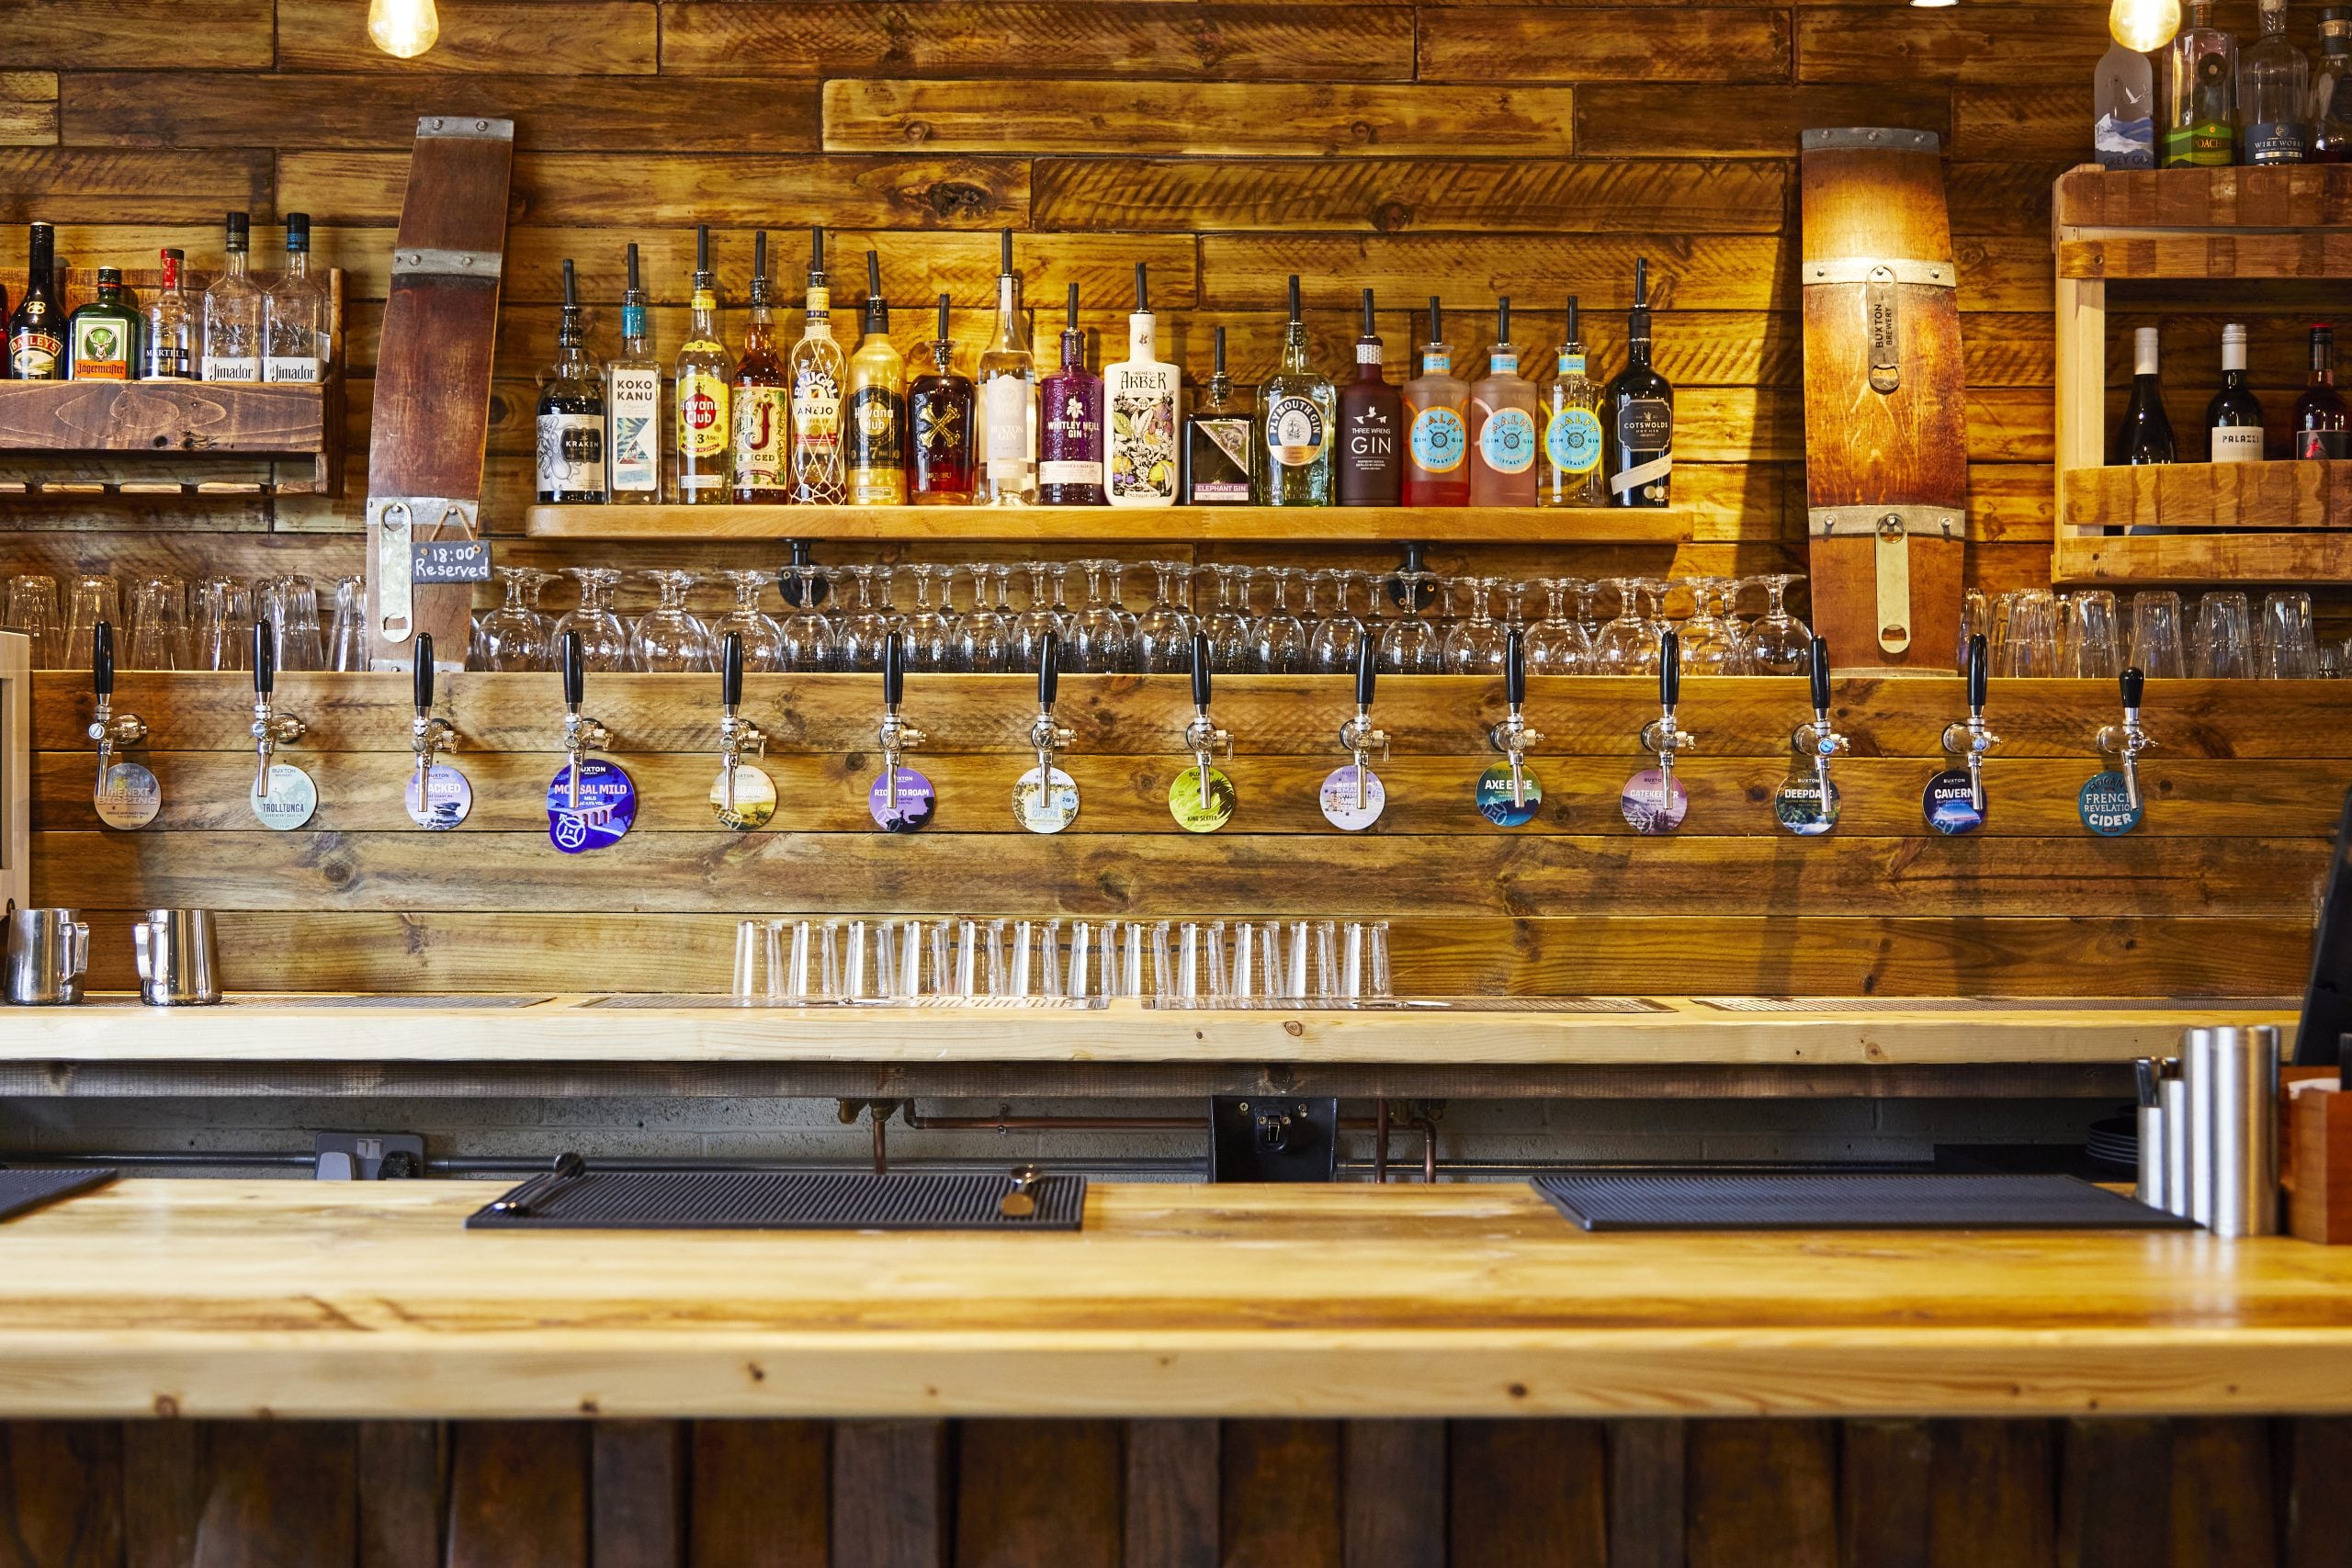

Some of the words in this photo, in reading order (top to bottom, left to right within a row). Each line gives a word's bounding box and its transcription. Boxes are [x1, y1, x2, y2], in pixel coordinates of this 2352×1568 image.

[2255, 140, 2277, 149] WIRE
[1874, 303, 1883, 348] BUXTON
[209, 364, 254, 381] Jimador
[272, 364, 316, 382] Jimador
[617, 379, 652, 389] KOKO
[1121, 370, 1167, 389] ARBER
[617, 391, 652, 401] KANU
[685, 411, 712, 423] Club
[1269, 399, 1312, 434] PLYMOUTH
[1311, 412, 1321, 434] GIN
[990, 425, 1023, 434] BUXTON
[1047, 421, 1080, 431] WHITLEY
[1082, 422, 1100, 431] NEILL
[696, 434, 705, 444] 3
[998, 432, 1017, 441] GIN
[1068, 430, 1082, 438] GIN
[565, 440, 599, 448] KRAKEN
[1351, 436, 1391, 455] GIN
[869, 446, 878, 459] 7
[433, 547, 475, 563] 18:00
[415, 557, 489, 578] Reserved
[415, 783, 461, 794] SACKED
[554, 784, 598, 795] MOSAL
[599, 784, 628, 795] MILD
[1484, 779, 1505, 790] AXE
[1506, 779, 1532, 790] EGE
[1630, 789, 1679, 799] GATEKEER
[1784, 788, 1833, 799] DEEPDAE
[263, 803, 305, 813] TROLLTUNGA
[2088, 812, 2133, 827] CIDER
